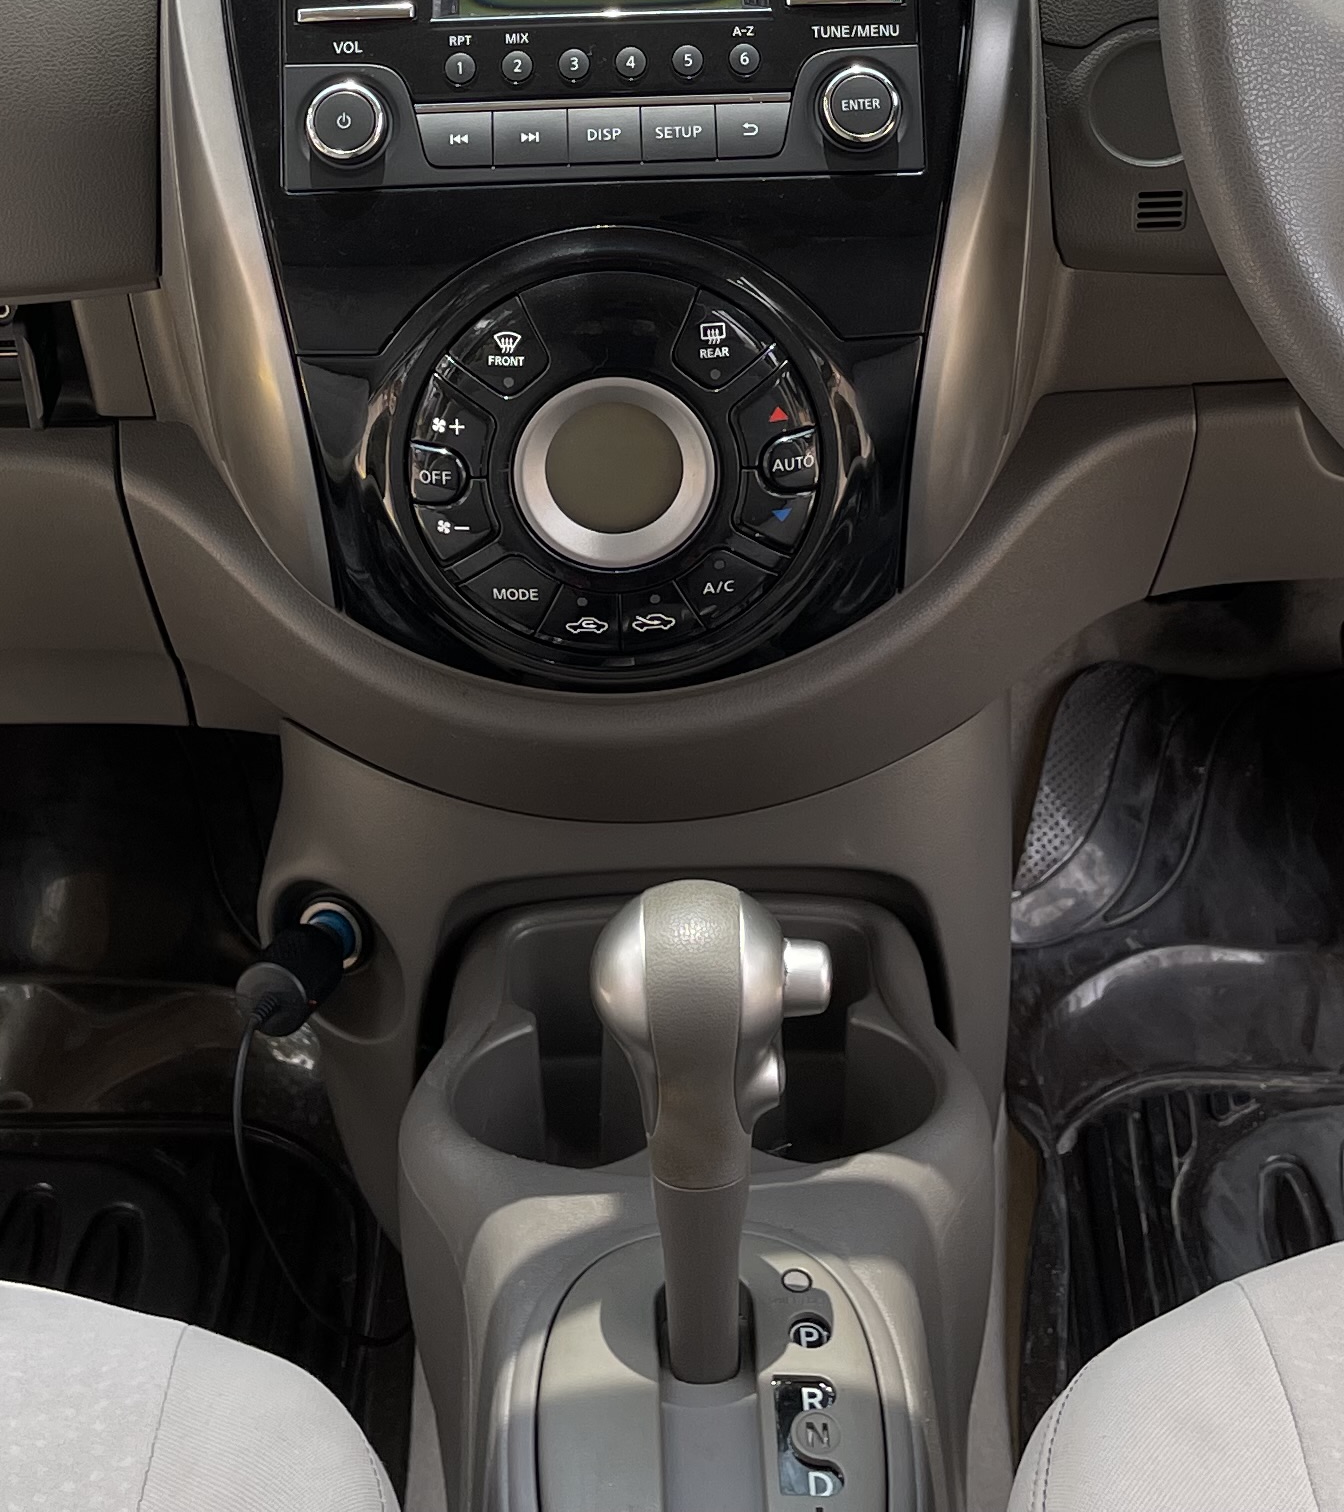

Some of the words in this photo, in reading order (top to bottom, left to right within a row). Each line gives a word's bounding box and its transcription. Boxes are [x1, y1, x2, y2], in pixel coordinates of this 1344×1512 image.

[505, 32, 530, 45] MIX
[732, 25, 756, 38] A-Z
[810, 24, 901, 39] TUNE/MENU
[332, 40, 364, 55] VOL
[448, 34, 473, 48] RPT
[512, 58, 523, 74] 2
[569, 56, 580, 72] 3
[625, 55, 637, 71] 4
[683, 53, 694, 68] 5
[739, 51, 751, 67] 6
[455, 61, 464, 76] 1
[840, 97, 882, 112] ENTER
[586, 127, 622, 142] DISP
[654, 125, 703, 140] SETUP
[699, 346, 730, 360] REAR
[487, 354, 525, 368] FRONT
[771, 454, 815, 473] AUTO
[418, 469, 452, 486] OFF
[702, 579, 736, 595] A/C
[491, 588, 540, 602] MODE
[799, 1327, 819, 1348] P
[801, 1387, 824, 1411] R
[805, 1421, 831, 1448] N
[808, 1471, 834, 1497] D
